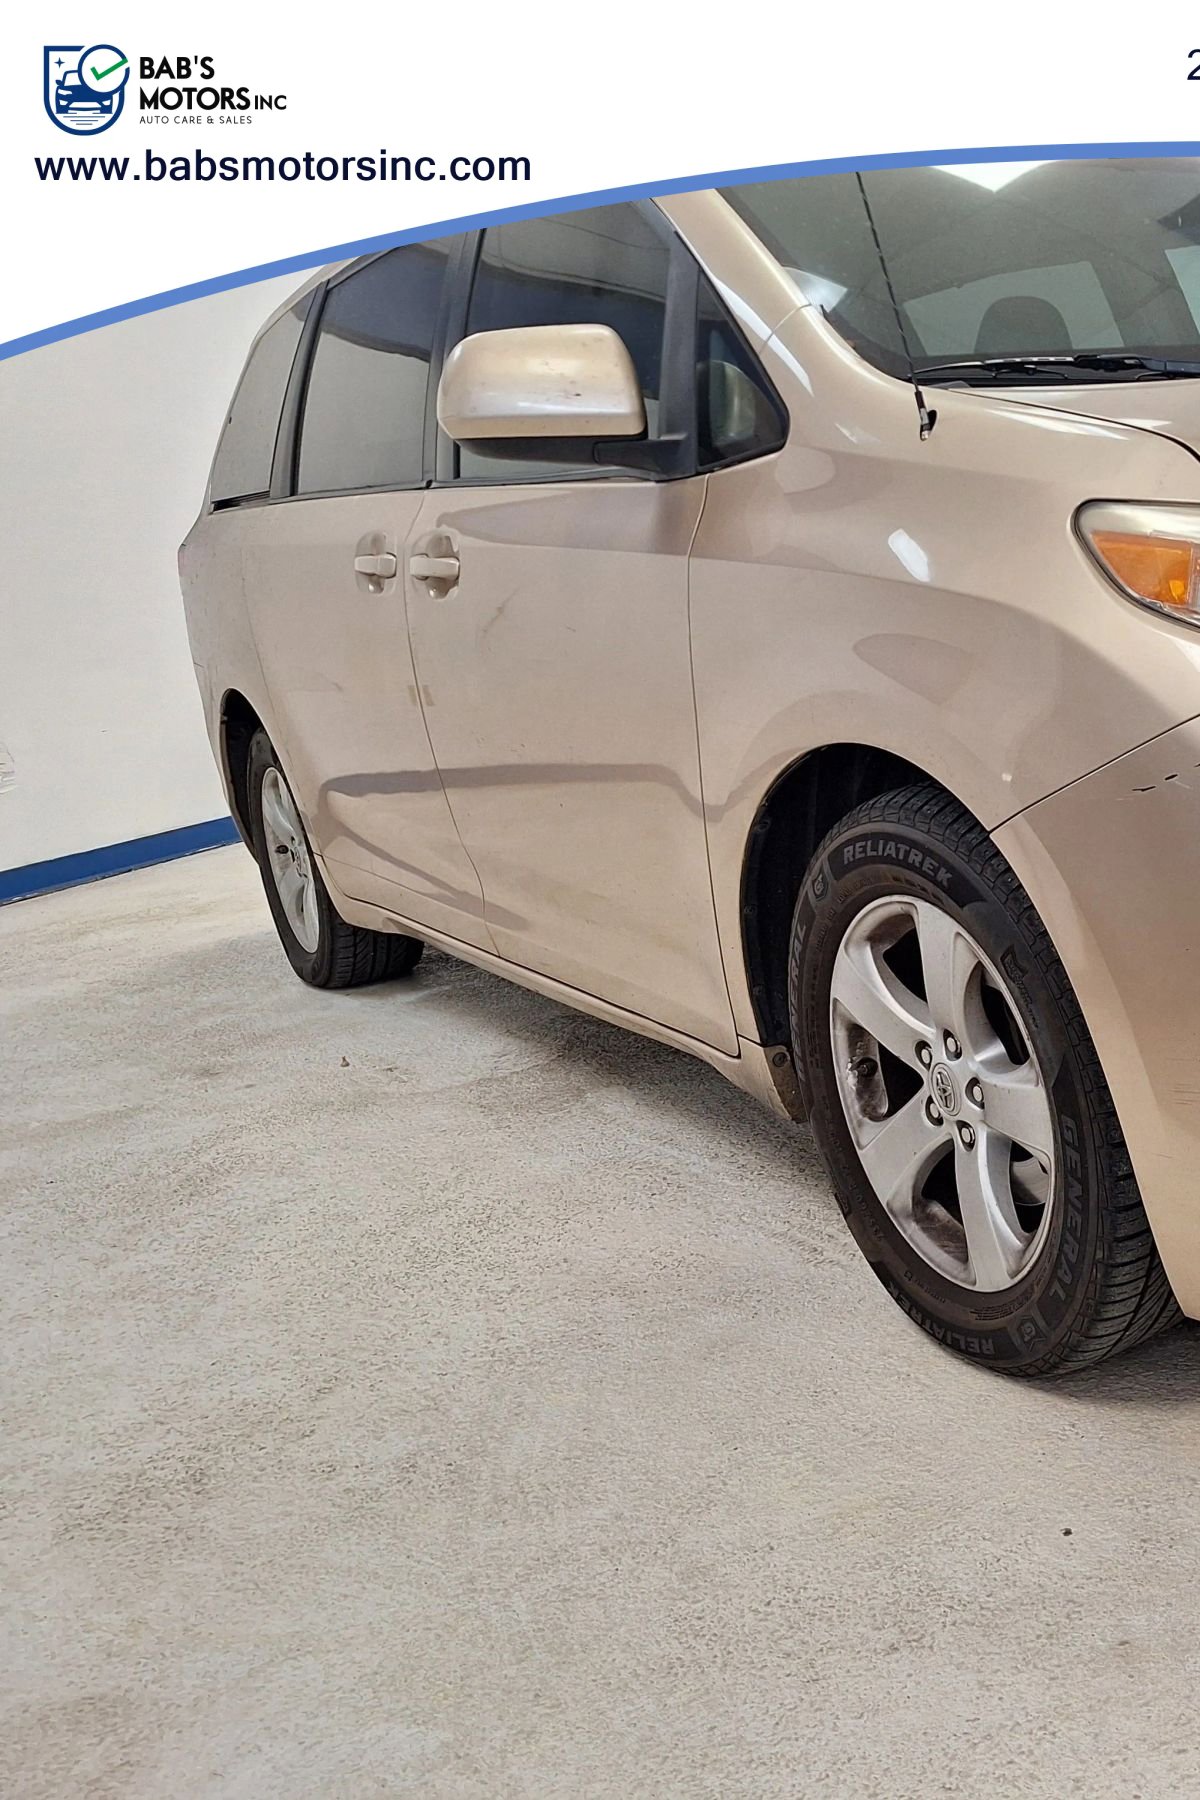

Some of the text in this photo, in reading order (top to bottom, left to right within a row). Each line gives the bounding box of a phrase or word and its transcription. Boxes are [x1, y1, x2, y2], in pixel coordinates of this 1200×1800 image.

[842, 839, 953, 888] RELIATREK
[1049, 1114, 1083, 1301] GENERAL
[886, 1281, 996, 1355] RELIATREK
